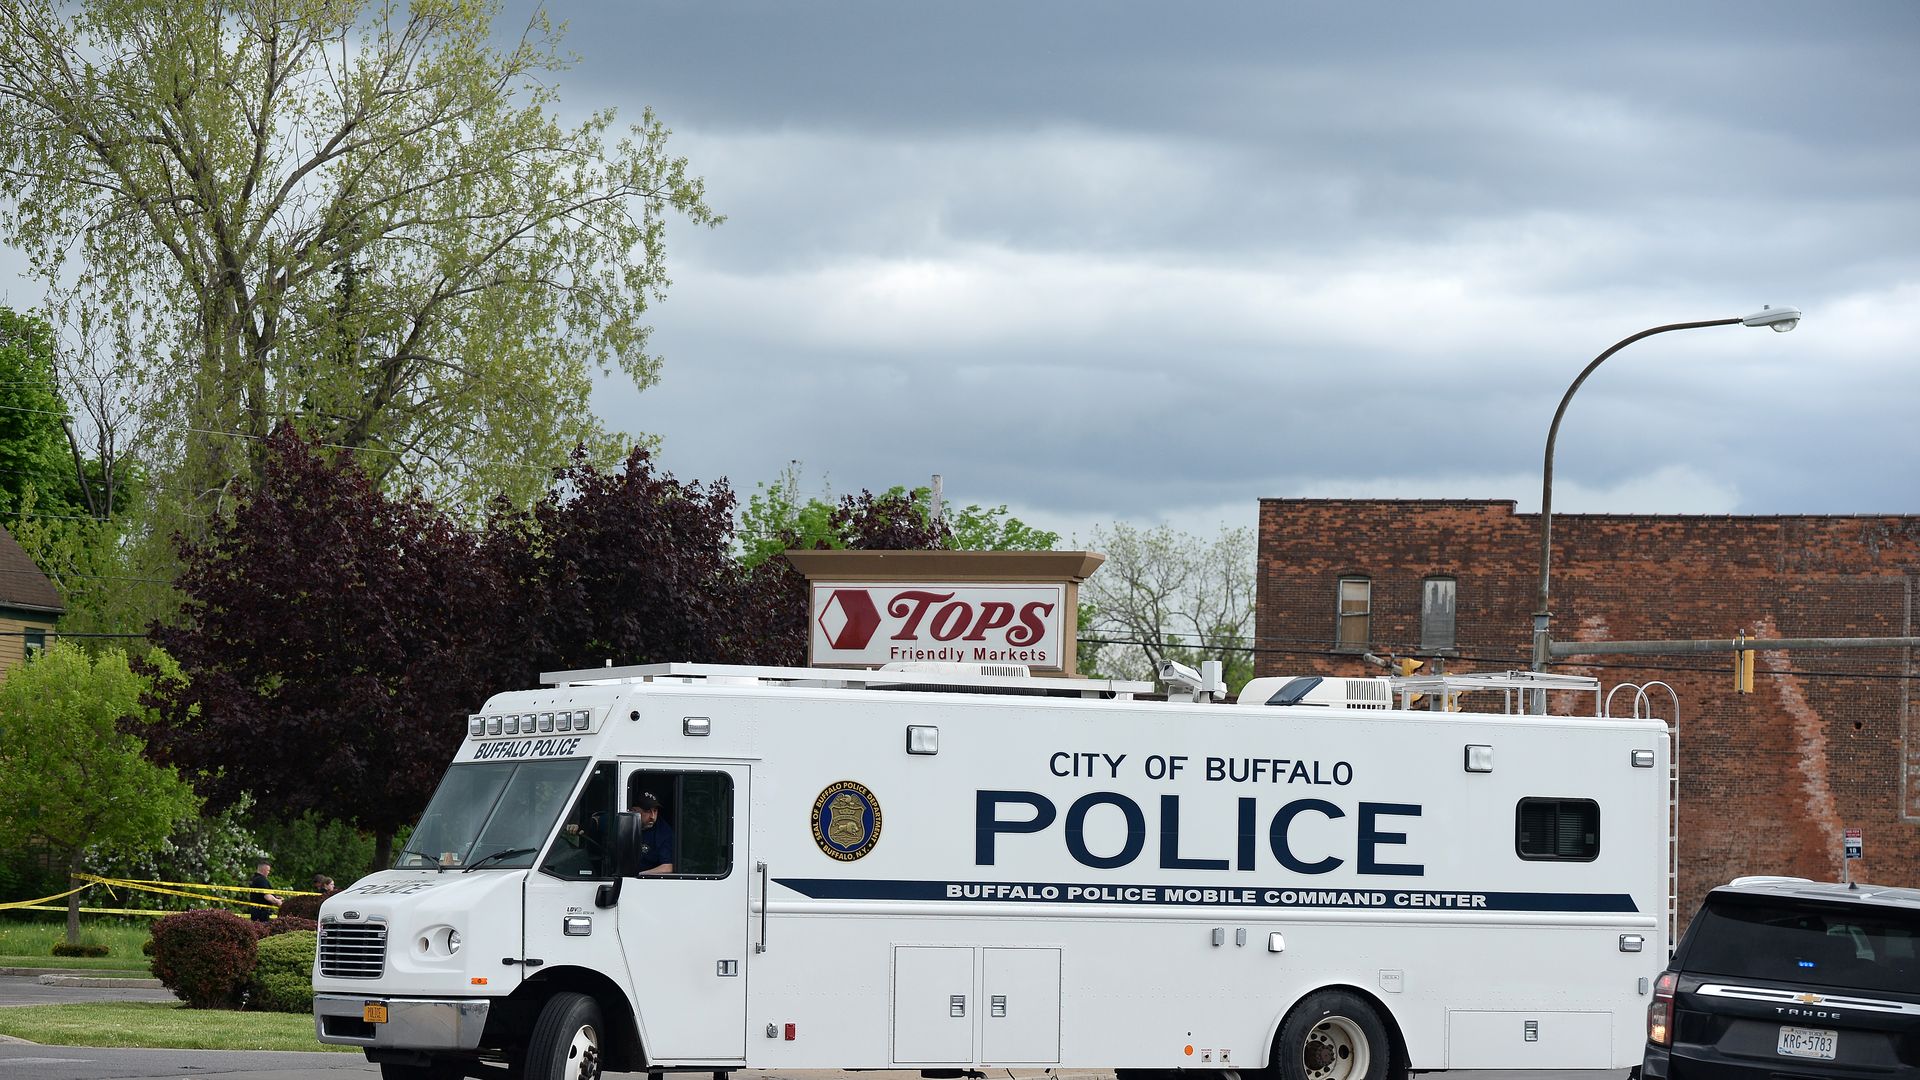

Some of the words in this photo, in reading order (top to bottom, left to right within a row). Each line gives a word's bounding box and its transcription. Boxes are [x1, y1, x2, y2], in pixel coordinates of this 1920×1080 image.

[888, 591, 1054, 647] TOPS
[890, 647, 964, 662] Friendly
[974, 647, 1046, 661] Markets
[473, 741, 532, 759] BUFFALO
[530, 738, 581, 756] POLICE
[1050, 751, 1127, 778] CITY
[1145, 755, 1189, 780] OF
[1206, 757, 1353, 785] BUFFALO
[813, 809, 820, 820] OF
[817, 783, 841, 808] BUFFALO
[843, 782, 867, 794] POLICE
[867, 793, 881, 842] DEPARTMENT
[976, 789, 1425, 875] POLICE
[946, 884, 1059, 899] BUFFALO
[1067, 886, 1156, 901] POLICE
[1165, 888, 1257, 903] MOBILE
[1264, 890, 1393, 905] COMMAND
[1394, 893, 1487, 907] CENTER
[1776, 1007, 1840, 1019] TAHOE
